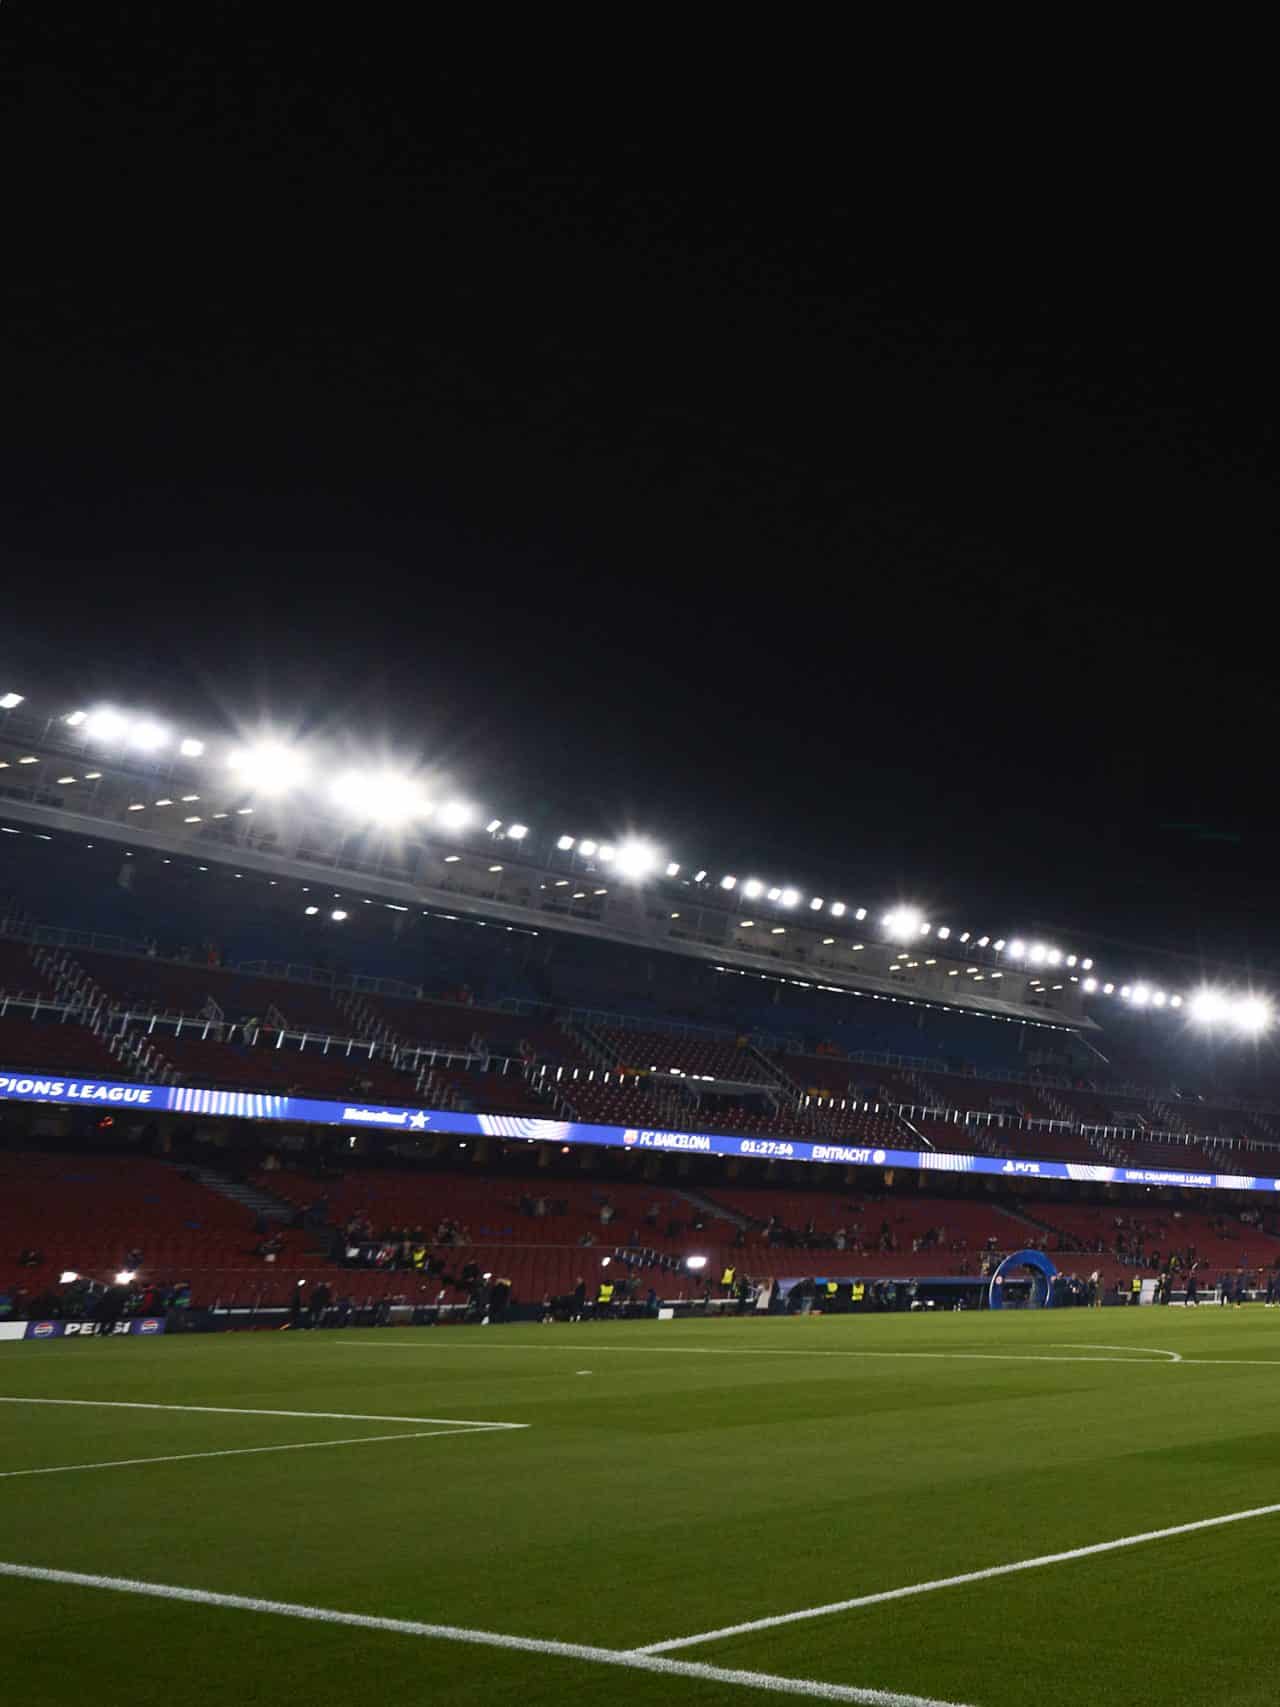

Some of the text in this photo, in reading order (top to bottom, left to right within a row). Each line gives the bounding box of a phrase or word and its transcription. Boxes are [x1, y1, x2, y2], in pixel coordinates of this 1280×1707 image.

[67, 1084, 152, 1103] LEAGUE
[640, 1131, 710, 1150] FC BARCELONA
[812, 1145, 872, 1162] EINTRACHT
